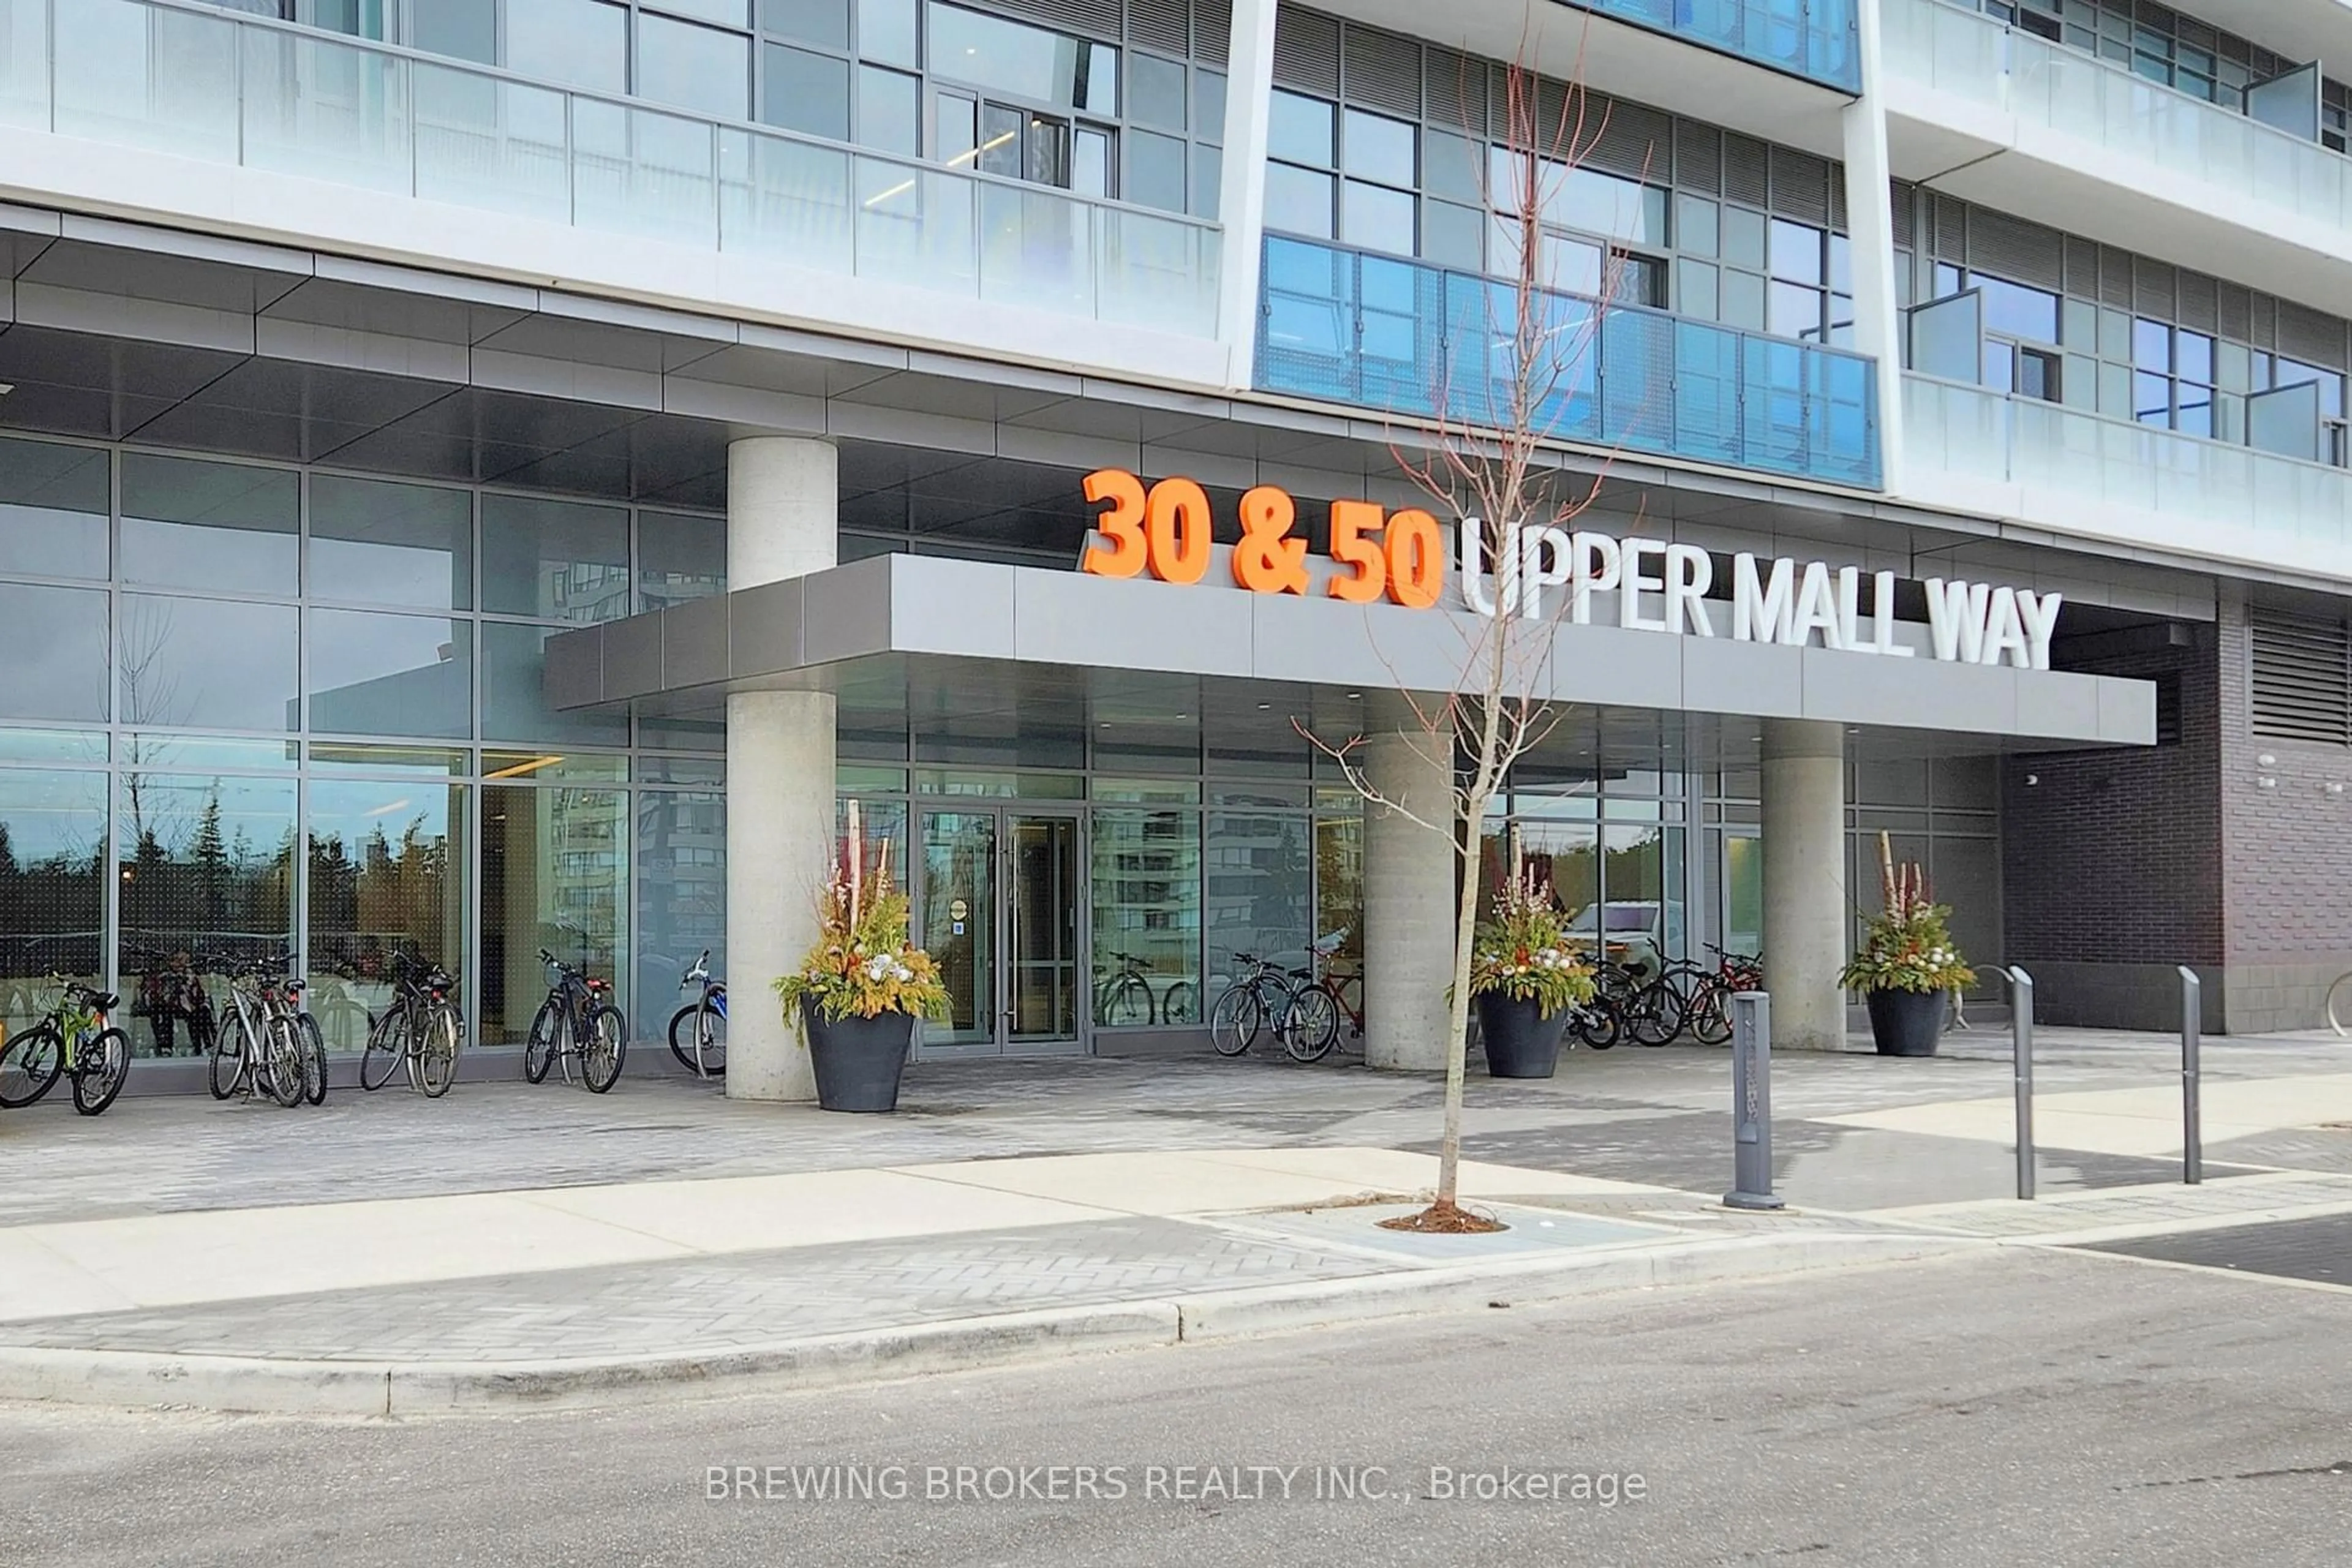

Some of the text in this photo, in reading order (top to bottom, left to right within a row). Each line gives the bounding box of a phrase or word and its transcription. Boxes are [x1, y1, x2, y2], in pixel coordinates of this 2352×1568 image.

[1082, 468, 2063, 670] 30 & 50 UPPER MALL WAY
